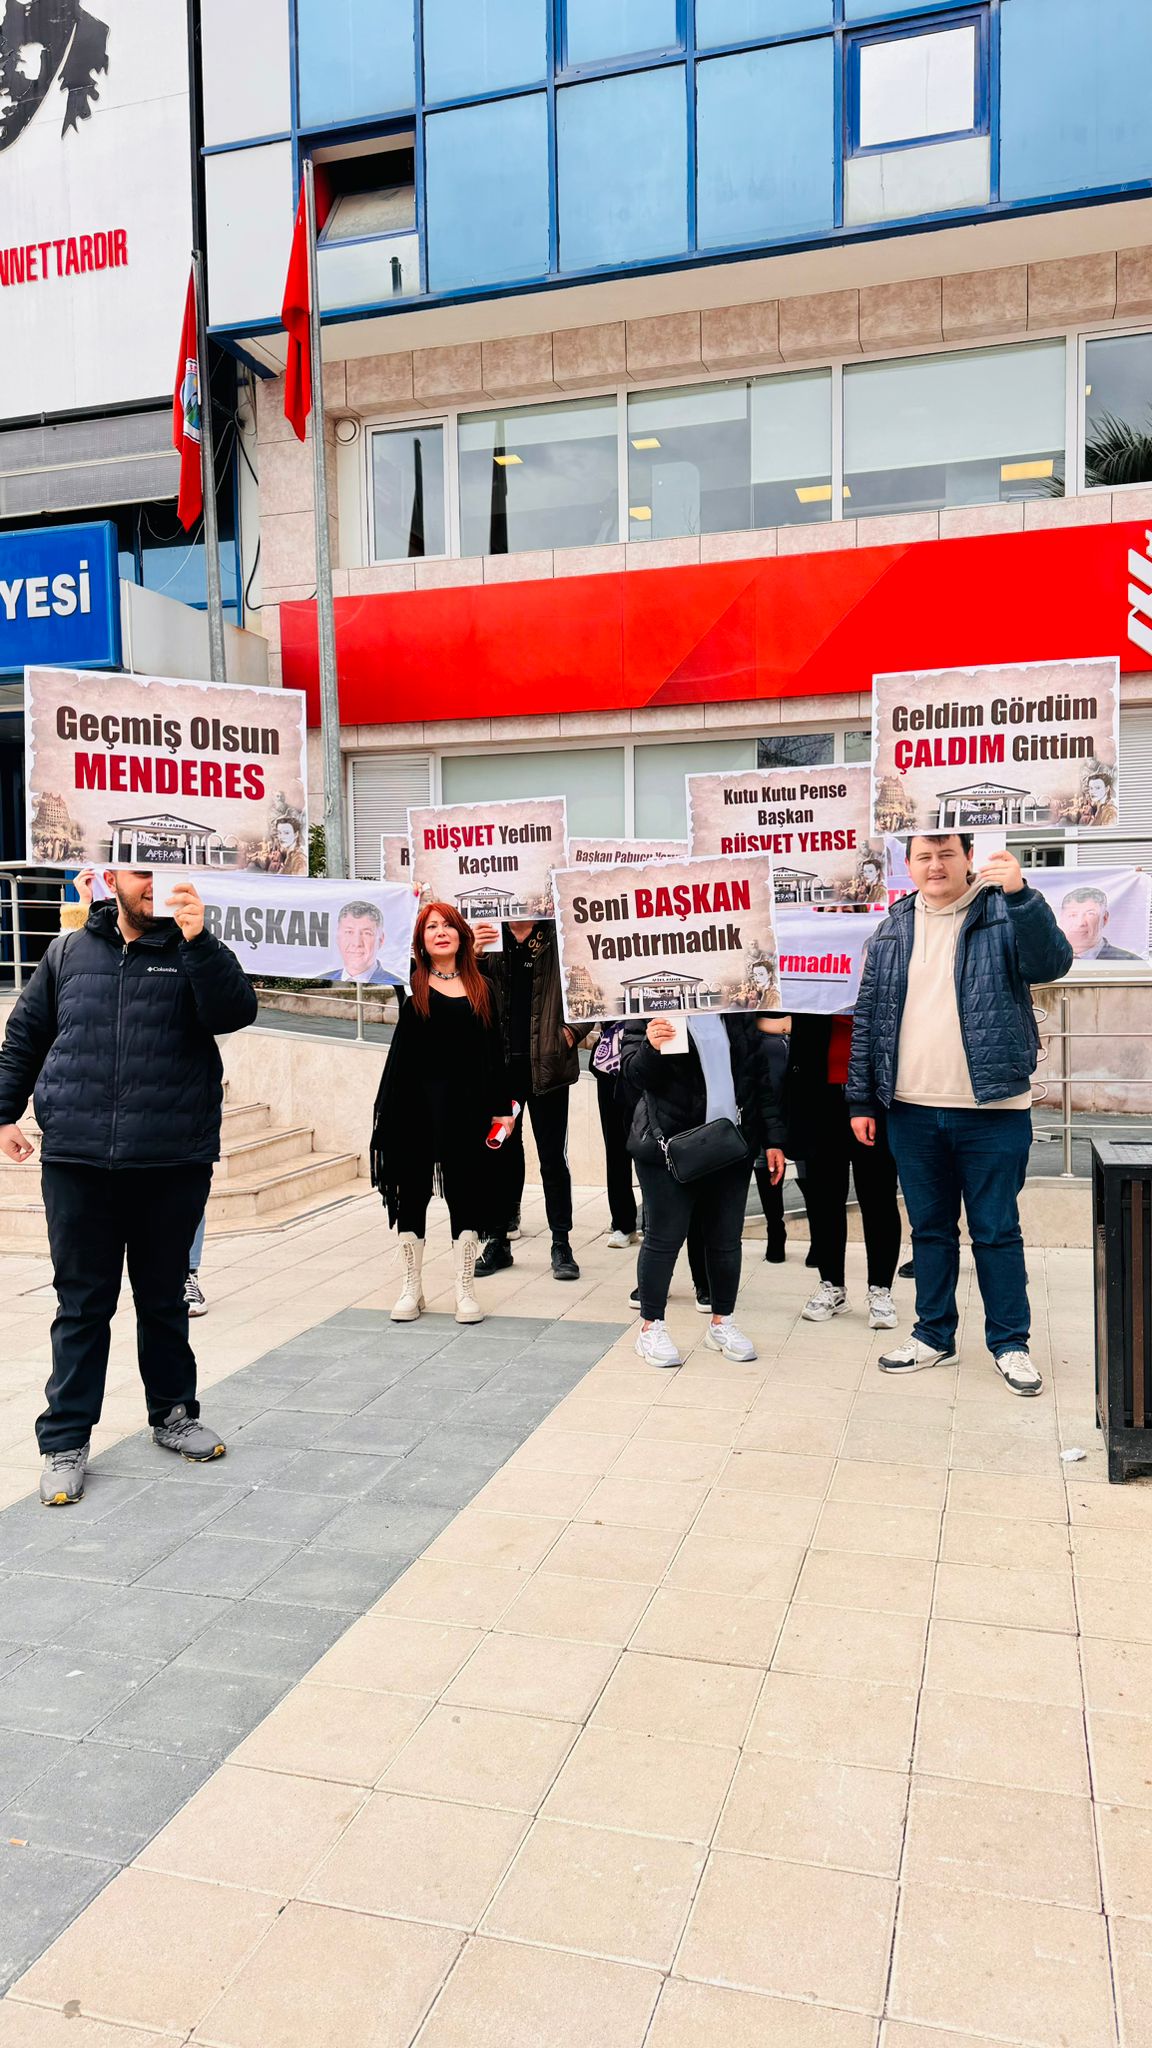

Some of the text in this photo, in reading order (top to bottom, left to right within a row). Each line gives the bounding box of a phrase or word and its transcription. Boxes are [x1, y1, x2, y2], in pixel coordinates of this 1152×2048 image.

[0, 560, 91, 620] YESİ
[56, 705, 280, 755] Geçmiş Olsun
[892, 694, 1097, 732] Geldim Gördüm
[894, 733, 1094, 775] ÇALDIM Gittim
[75, 752, 265, 800] MENDERES
[724, 784, 847, 805] Kutu Kutu Pense
[758, 808, 813, 827] Başkan
[423, 823, 552, 852] RÜŞVET Yedim
[798, 829, 857, 852] YERSE
[458, 855, 519, 877] Kaçtım
[576, 850, 613, 864] Başkan
[572, 880, 751, 923] Seni BAŞKAN
[204, 904, 329, 950] BAŞKAN
[587, 923, 743, 961] Yaptırmadık
[779, 953, 852, 974] rmadık
